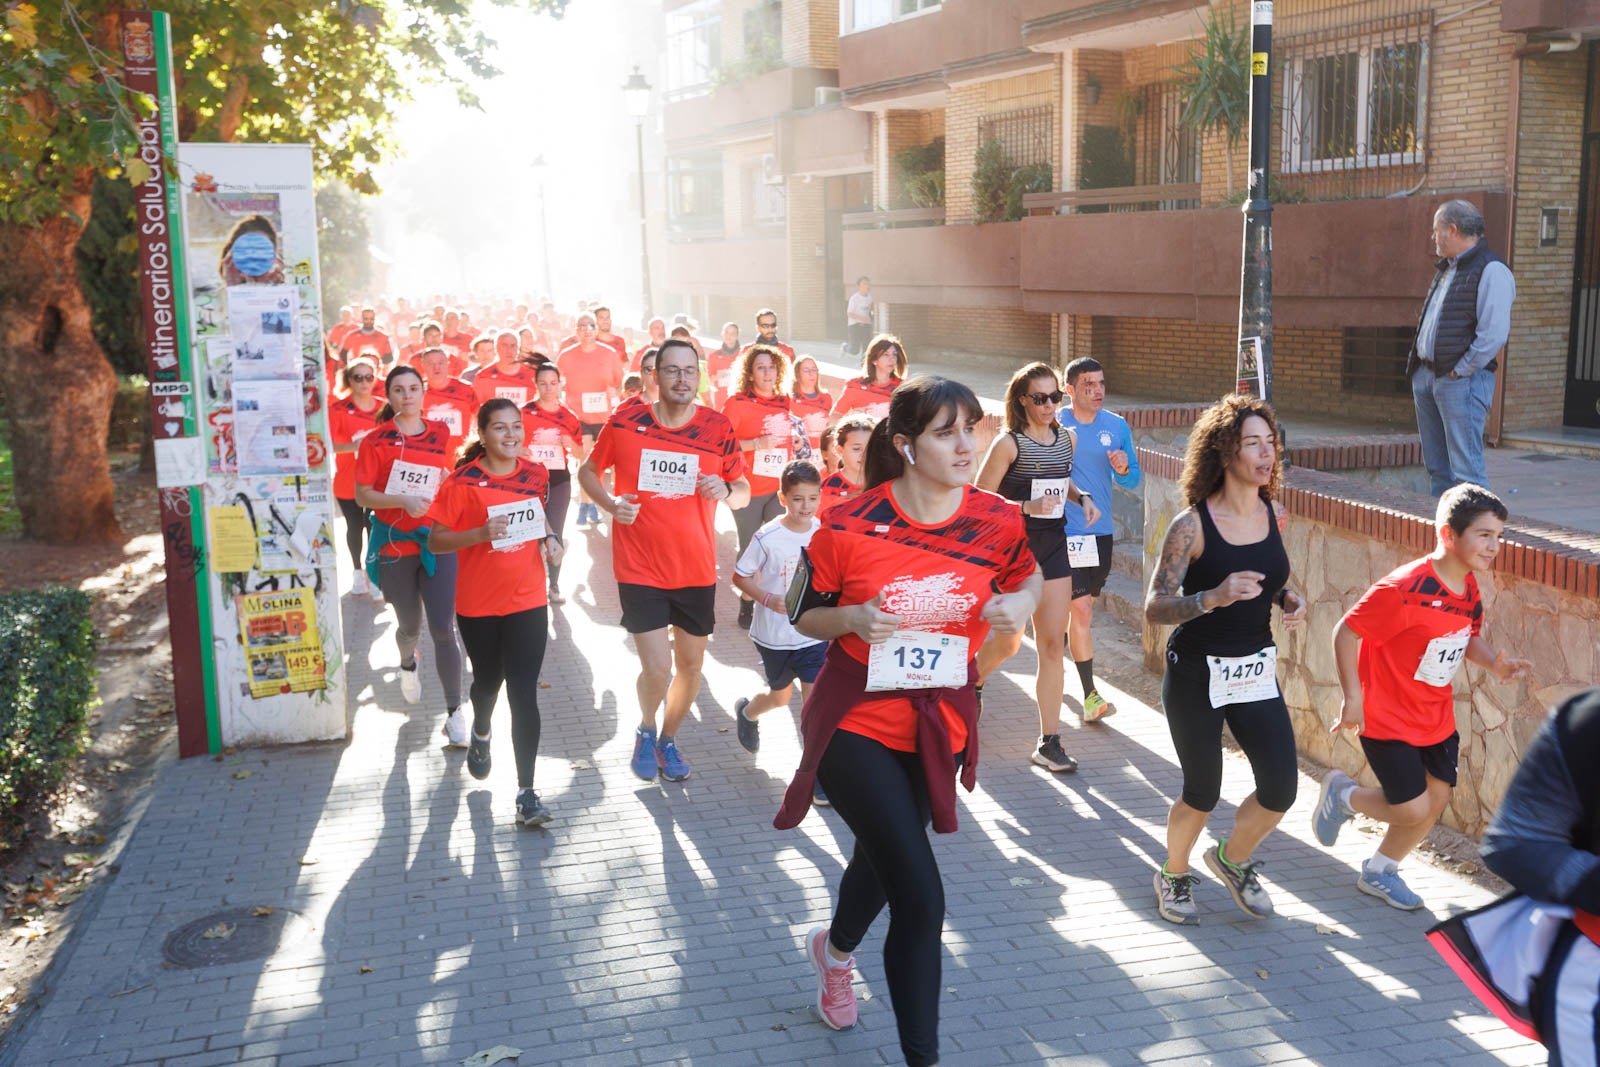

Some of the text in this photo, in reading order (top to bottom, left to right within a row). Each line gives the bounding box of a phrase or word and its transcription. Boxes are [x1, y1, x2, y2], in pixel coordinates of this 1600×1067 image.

[145, 242, 174, 360] tinerarios
[154, 384, 189, 393] MPS
[537, 450, 555, 458] 718
[764, 454, 783, 464] 670
[650, 459, 687, 475] 1004
[399, 470, 429, 485] 1521
[248, 597, 302, 611] MOLINA
[285, 611, 308, 636] B
[287, 655, 309, 669] 149
[894, 646, 942, 671] 137
[1222, 661, 1264, 681] 1470
